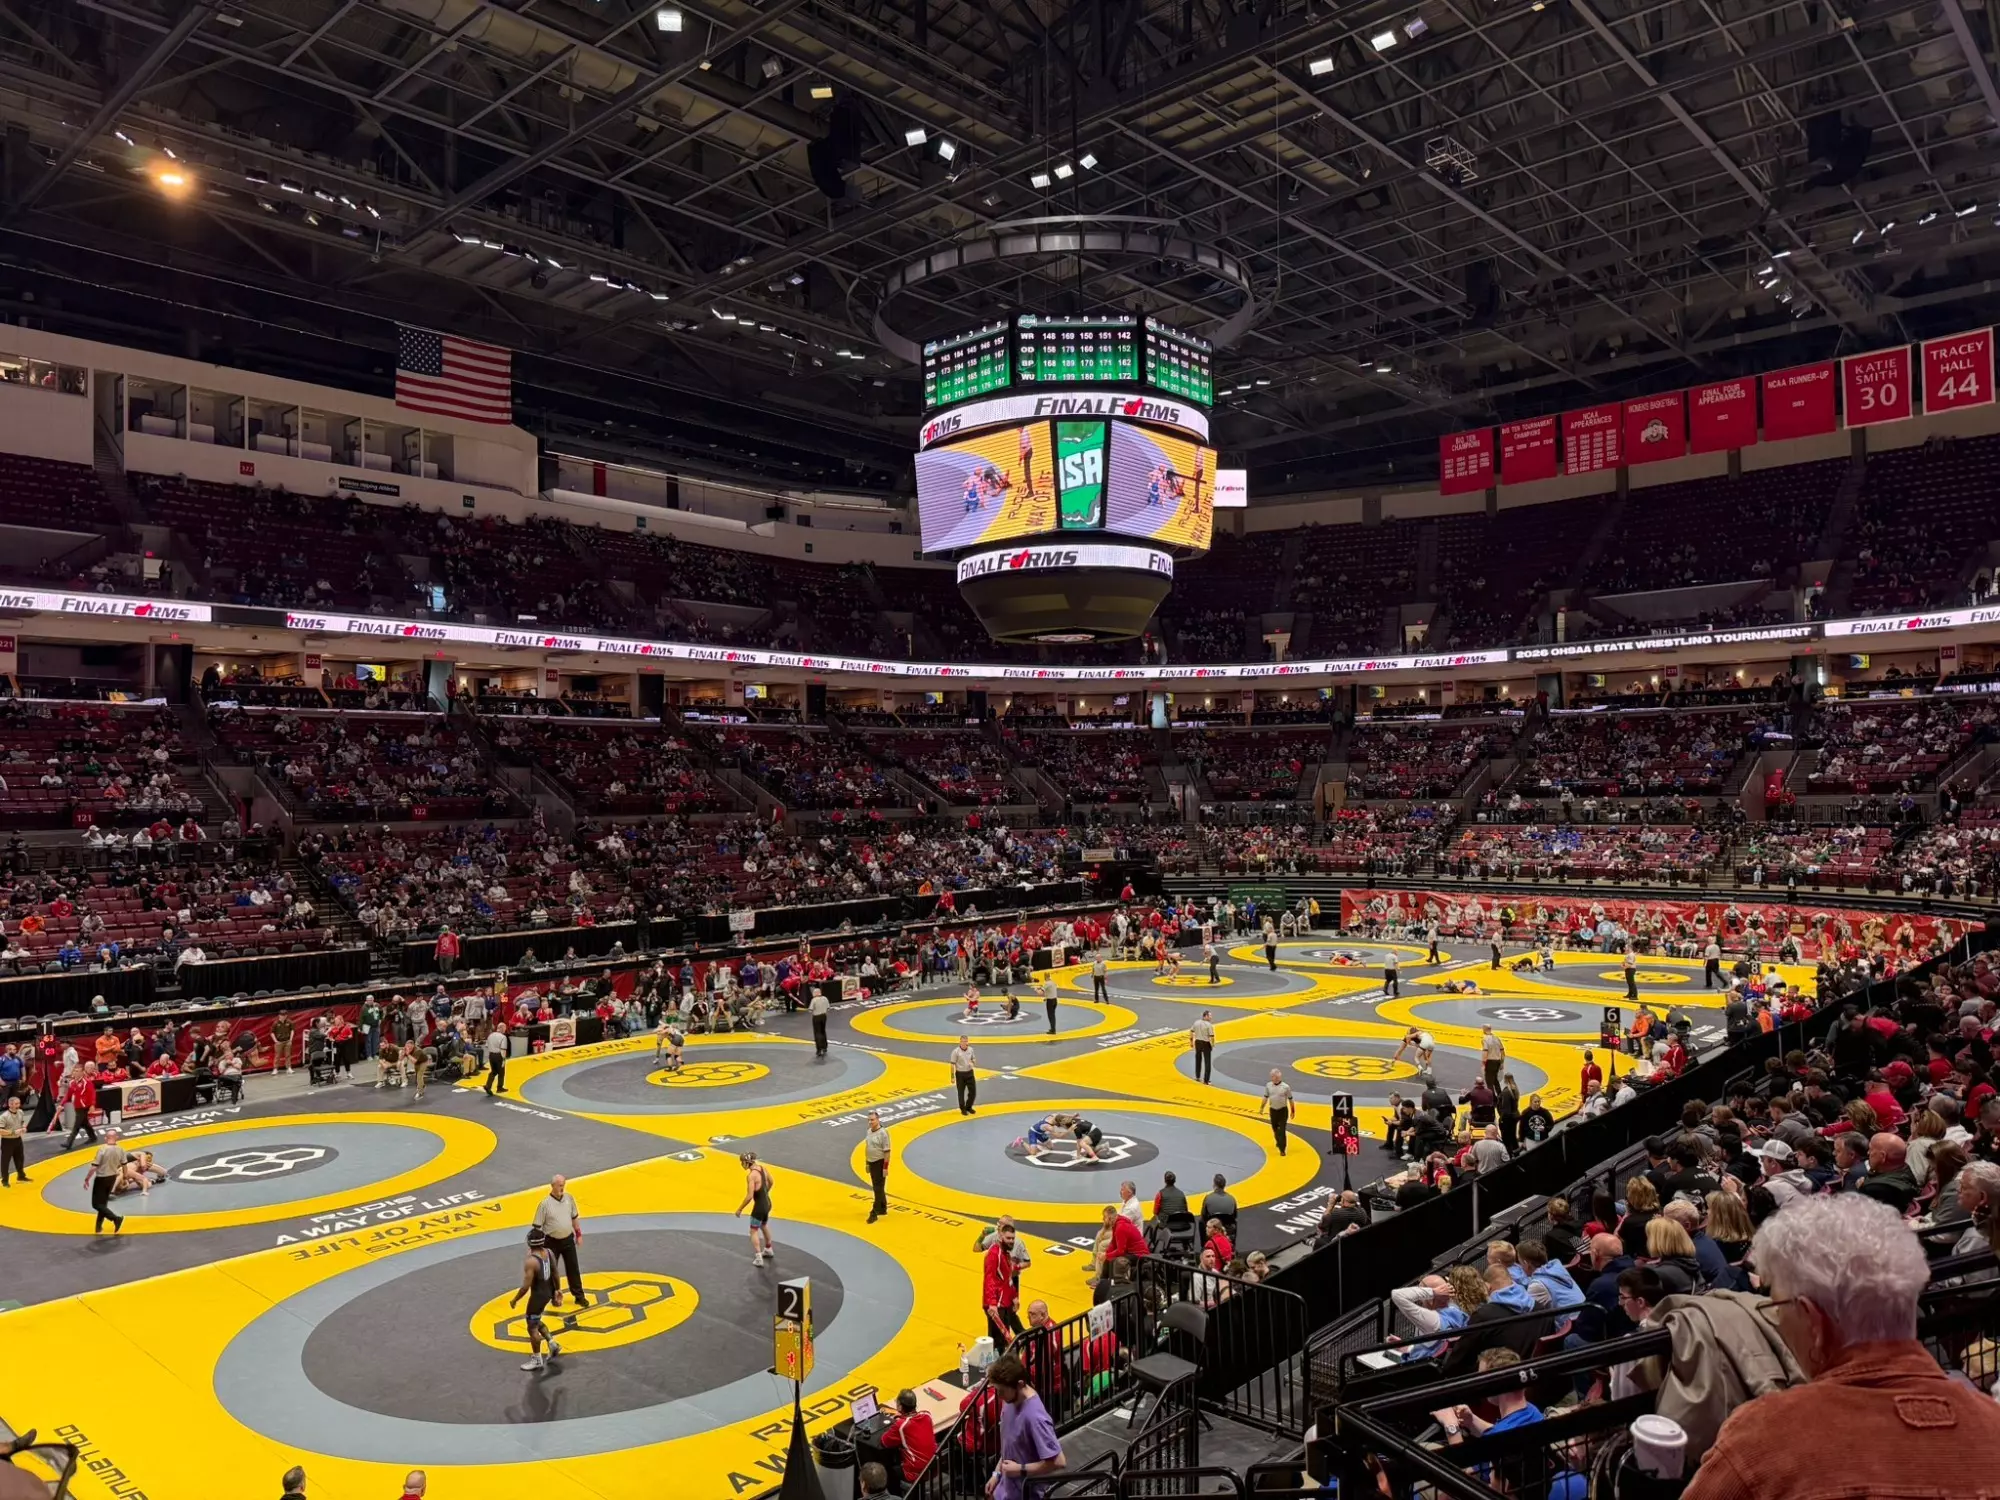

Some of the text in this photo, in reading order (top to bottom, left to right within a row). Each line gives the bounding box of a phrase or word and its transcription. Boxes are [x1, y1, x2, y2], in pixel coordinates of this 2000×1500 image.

[968, 330, 974, 338] 3
[996, 320, 1002, 328] 5
[1021, 332, 1034, 340] WR
[1042, 332, 1056, 340] 148
[1080, 332, 1094, 340] 150
[1930, 340, 1984, 360] TRACEY
[994, 364, 1004, 372] 177
[1855, 358, 1896, 374] KATIE
[1940, 358, 1974, 374] HALL
[1768, 370, 1830, 389] NCAA RUNNER-UP
[1856, 369, 1898, 385] SMITH
[1703, 384, 1740, 397] FINAL FOUR
[1938, 372, 1980, 400] 44
[1650, 397, 1678, 410] BASKETBALL
[1698, 390, 1746, 406] APPEARANCES
[1860, 384, 1897, 410] 30
[1034, 396, 1180, 423] FINALFORMS
[1582, 412, 1599, 420] NCAA
[1522, 419, 1553, 432] TOURNAMENT
[1570, 416, 1612, 429] APPEARANCES
[1514, 429, 1540, 440] CHAMPIONS
[1452, 440, 1480, 452] CHAMPIONS
[960, 549, 1079, 580] FINALFORMS
[61, 597, 191, 619] FINALFORMS
[1850, 616, 1952, 633] FINALFORMS
[347, 620, 448, 638] FINALFORMS
[495, 632, 582, 649] FINALFORMS
[598, 640, 674, 656] FINALFORMS
[688, 648, 757, 663] FINALFORMS
[769, 654, 830, 668] FINALFORMS
[840, 660, 896, 673] FINALFORMS
[906, 664, 970, 676] FINALFORMS
[1004, 668, 1065, 679] FINALFORMS
[1078, 669, 1145, 679] FINALFORMS
[1159, 668, 1227, 678] FINALFORMS
[1240, 665, 1310, 676] FINALFORMS
[1324, 660, 1398, 672] FINALFORMS
[1414, 654, 1487, 668] FINALFORMS
[1516, 626, 1812, 660] 2026 OHSAA STATE WRESTLING TOURNAMENT
[76, 814, 92, 822] 121
[1020, 910, 1025, 918] 7
[801, 936, 806, 944] 5
[497, 971, 504, 982] 3
[1751, 963, 1759, 974] 8
[1607, 1008, 1618, 1022] 6
[816, 1102, 850, 1115] WAY
[854, 1096, 877, 1105] OF
[879, 1088, 918, 1100] LIFE
[896, 1098, 930, 1110] WAY
[1336, 1096, 1350, 1115] 4
[822, 1112, 868, 1127] LIFE
[1268, 1186, 1336, 1213] RUDIS
[310, 1195, 418, 1223] RUDIS
[276, 1190, 486, 1246] A WAY OF LIFE
[288, 1203, 502, 1261] A WAY OF LIFE
[1275, 1224, 1305, 1234] A
[784, 1288, 798, 1318] 2
[727, 1472, 764, 1494] A
